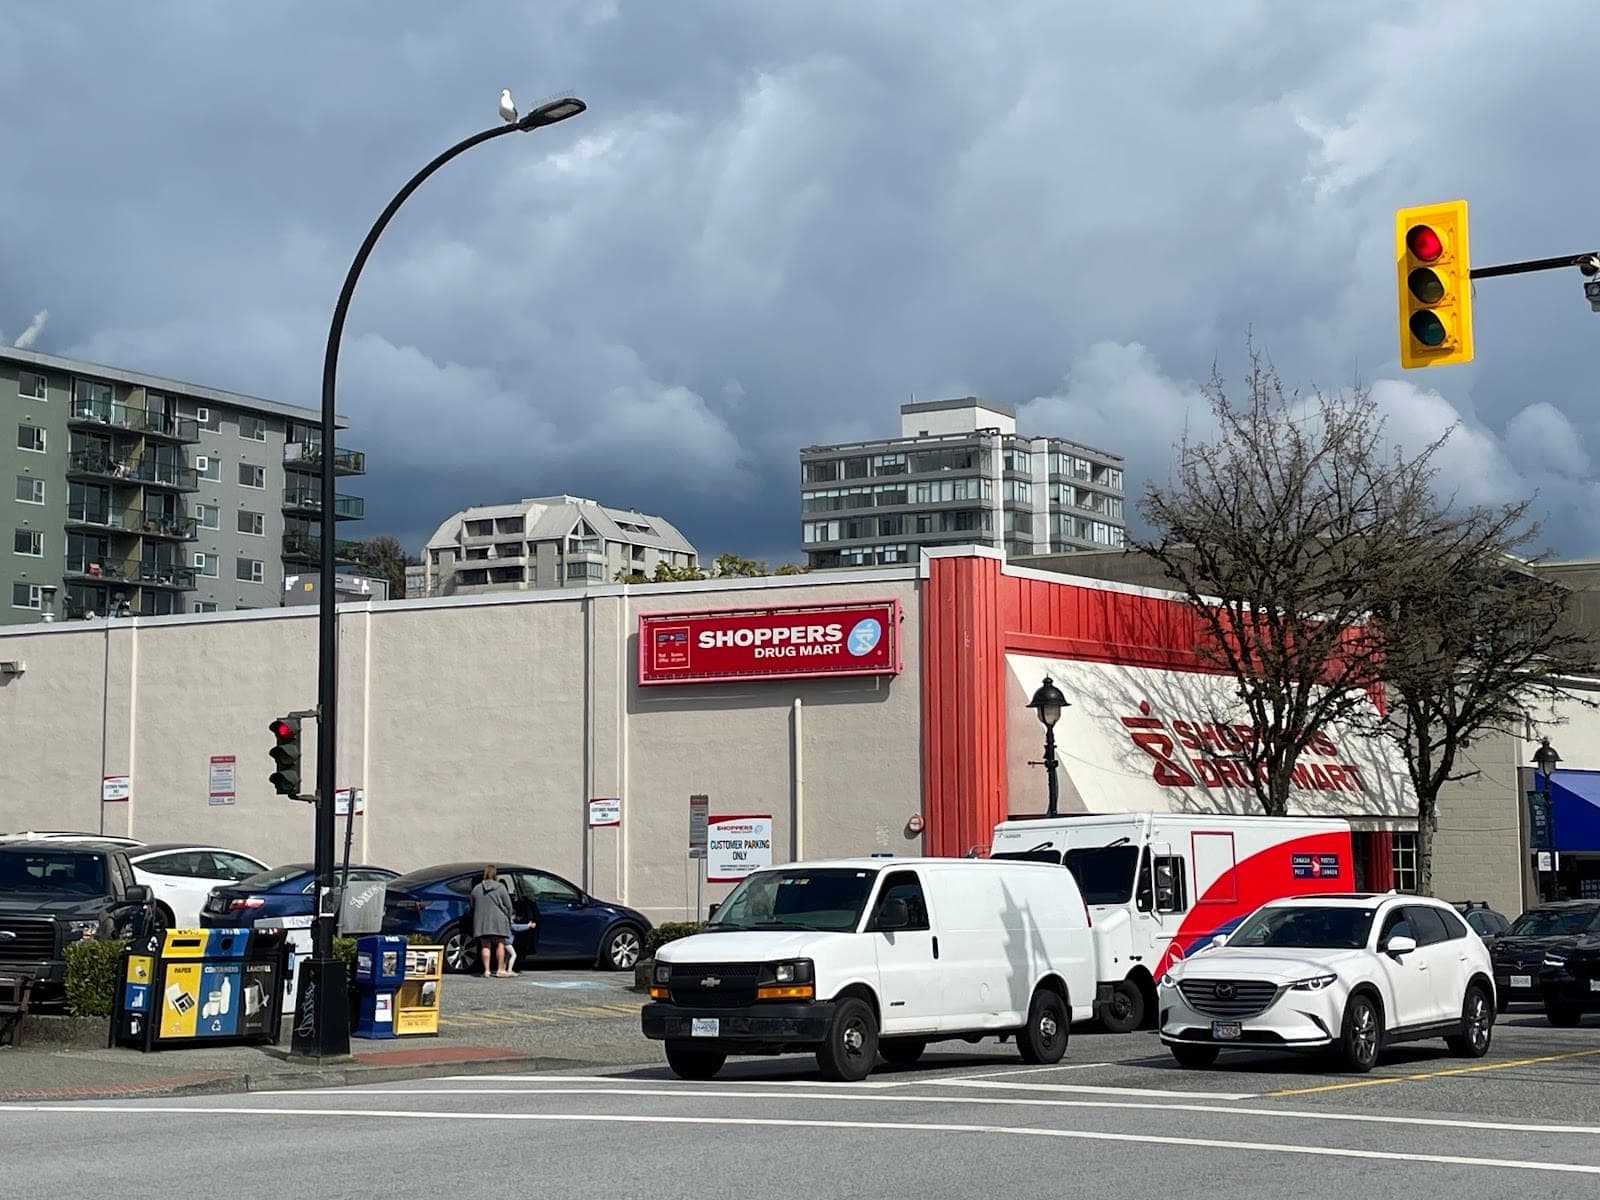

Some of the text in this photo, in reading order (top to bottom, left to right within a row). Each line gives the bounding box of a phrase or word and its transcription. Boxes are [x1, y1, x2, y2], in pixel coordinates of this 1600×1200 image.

[698, 623, 843, 649] SHOPPERS
[754, 643, 842, 659] DRUG MART
[1291, 762, 1366, 792] MART
[710, 839, 770, 850] CUSTOMER PARKING
[732, 851, 748, 861] ONLY
[1293, 856, 1310, 864] CANADA
